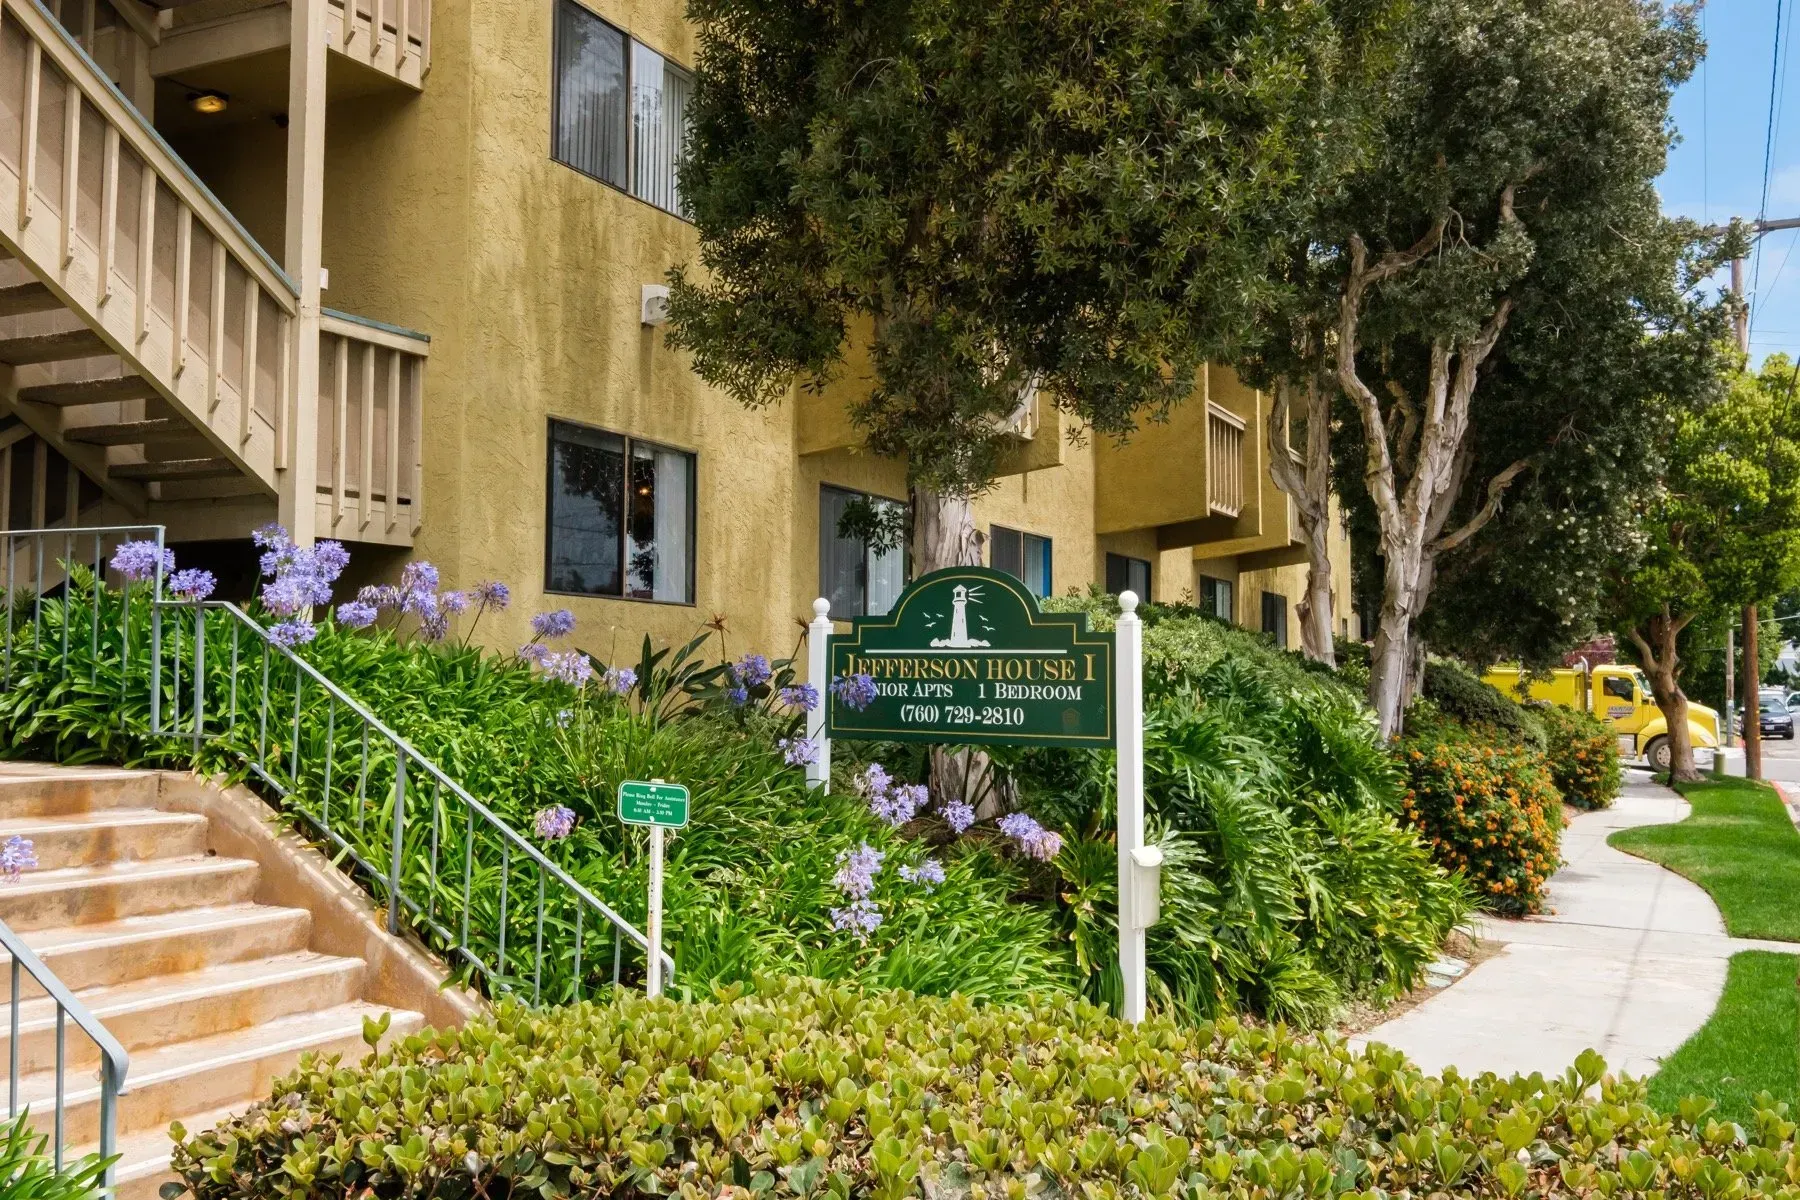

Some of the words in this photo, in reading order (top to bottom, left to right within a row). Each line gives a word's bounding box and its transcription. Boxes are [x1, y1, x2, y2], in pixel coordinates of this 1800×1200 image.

[842, 653, 980, 680] JEFFERSON
[986, 658, 1076, 681] HOUSE
[1084, 653, 1096, 681] I
[872, 682, 909, 697] NIOR
[912, 681, 953, 697] APTS
[978, 683, 986, 699] 1
[994, 682, 1082, 700] BEDROOM
[900, 704, 939, 723] (760)
[944, 705, 1025, 725] 729-2810
